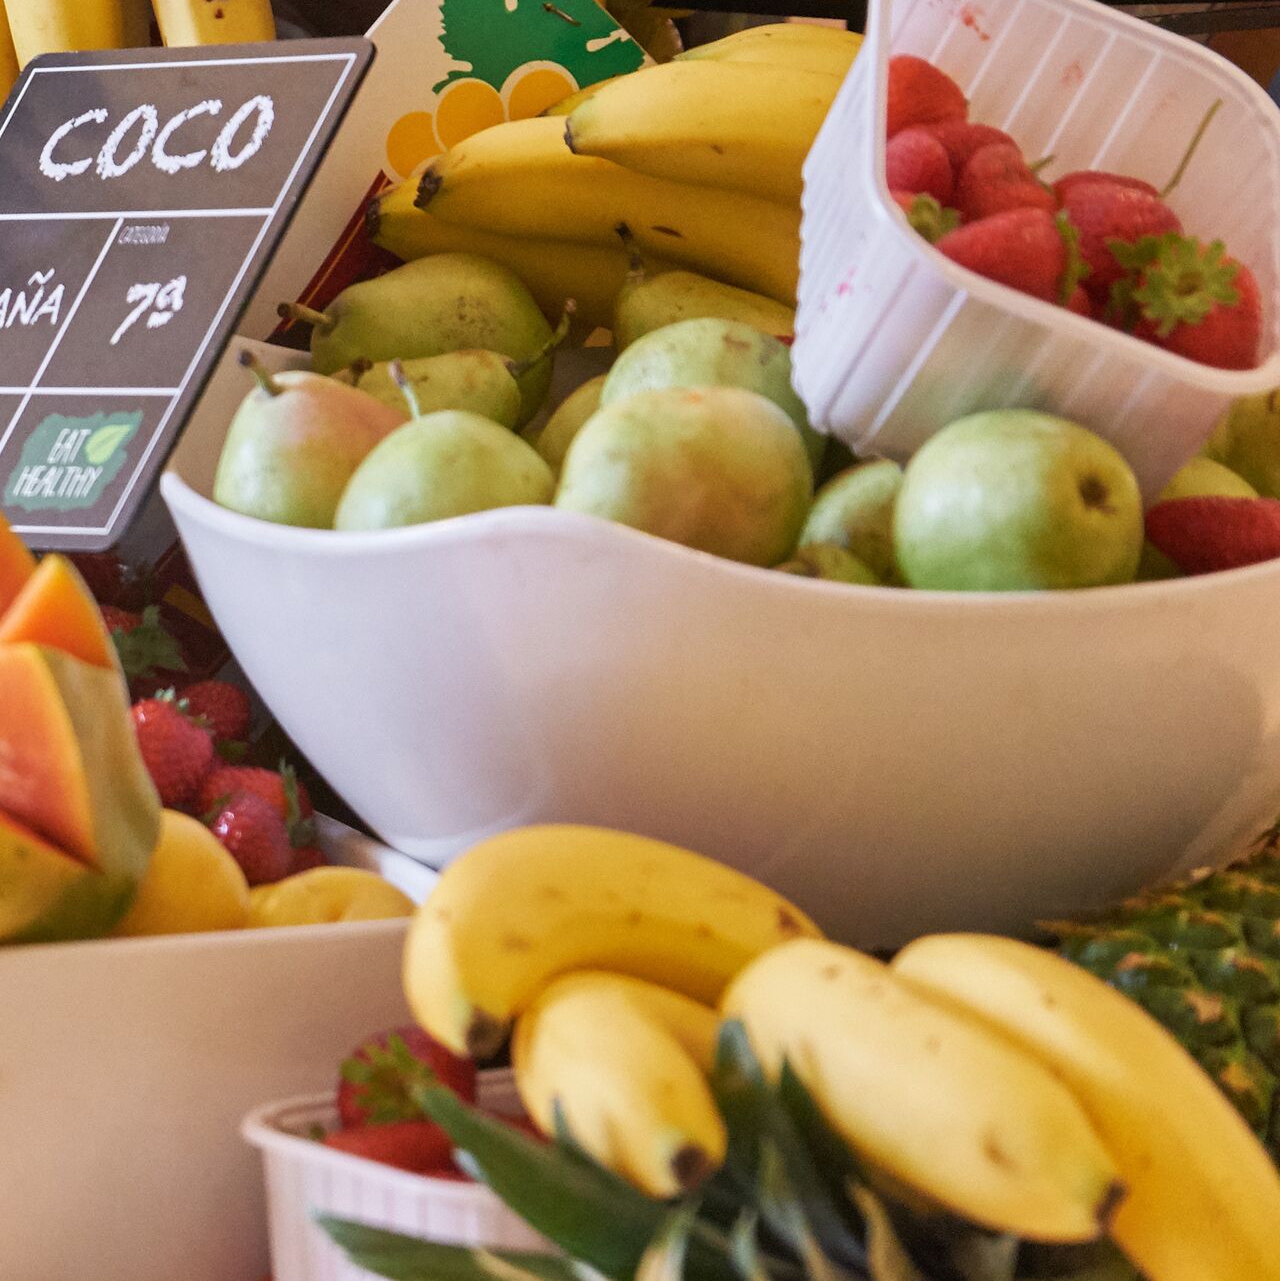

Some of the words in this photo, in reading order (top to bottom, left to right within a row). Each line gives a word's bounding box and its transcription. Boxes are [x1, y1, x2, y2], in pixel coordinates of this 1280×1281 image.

[38, 95, 274, 181] COCO
[47, 428, 92, 464] EAT
[13, 465, 103, 498] HEALTHY
